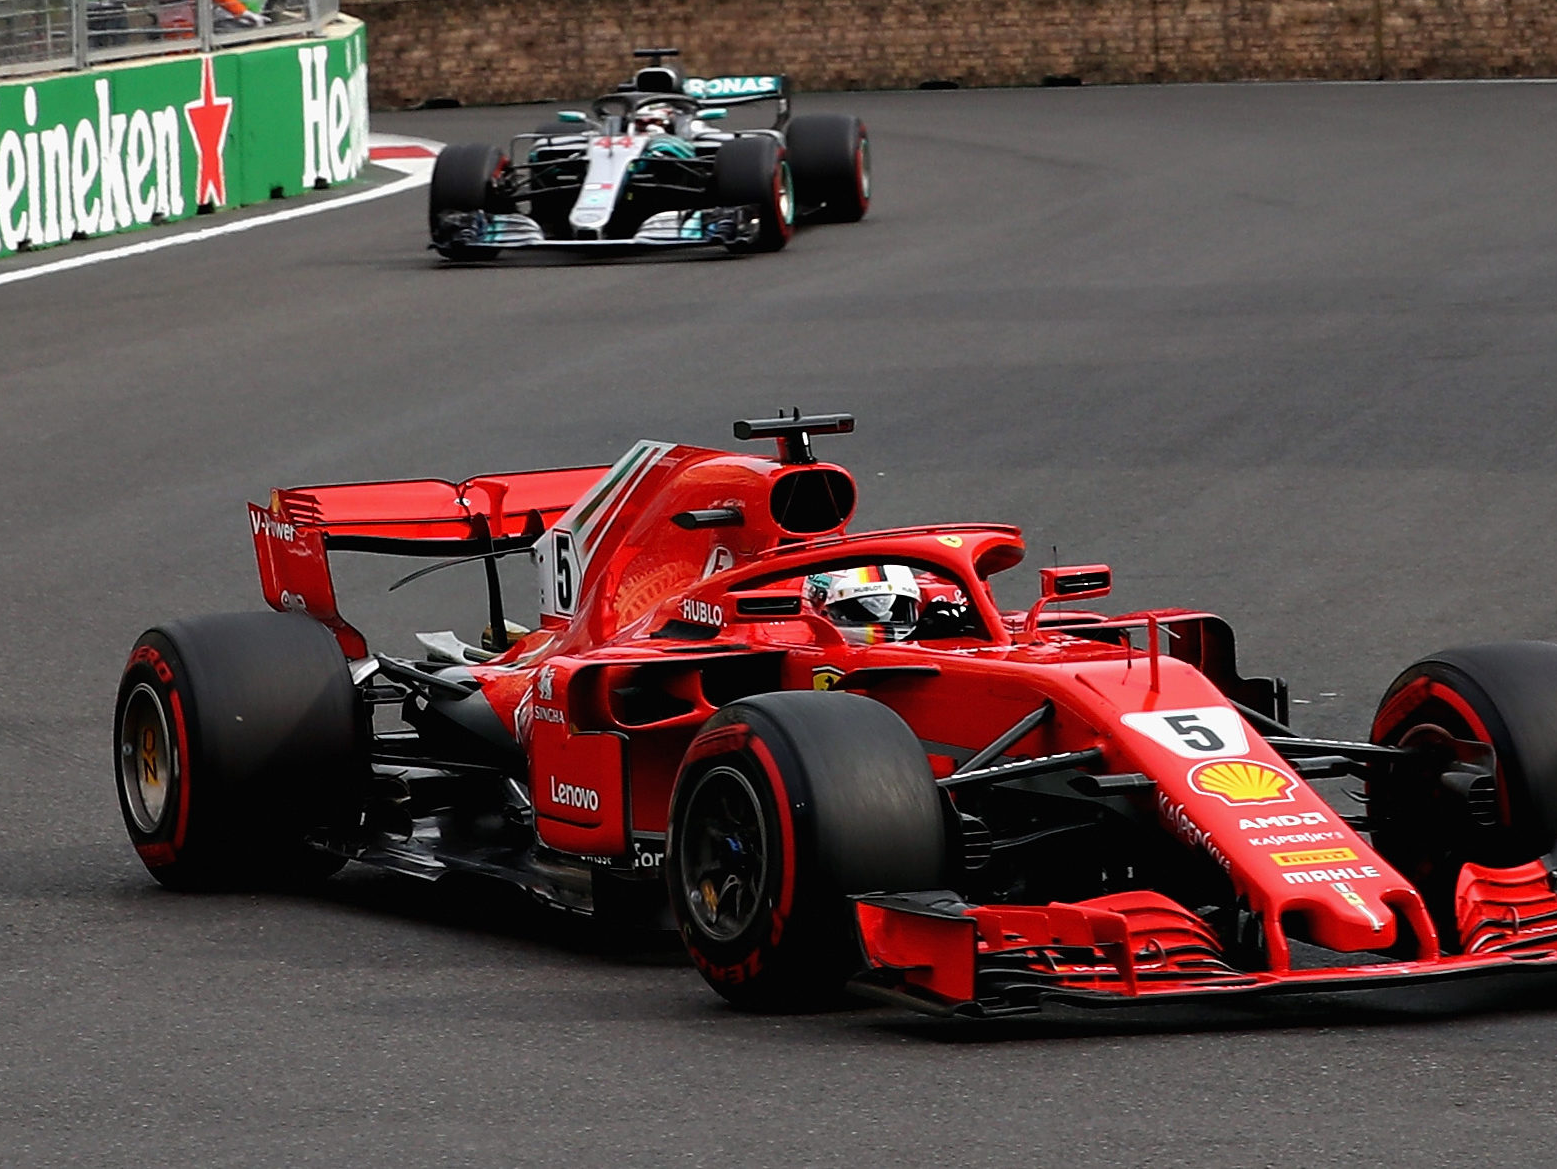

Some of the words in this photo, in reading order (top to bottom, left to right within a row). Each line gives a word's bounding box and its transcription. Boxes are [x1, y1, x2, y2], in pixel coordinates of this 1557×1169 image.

[594, 136, 634, 148] 44
[250, 510, 294, 543] V-Power
[554, 530, 573, 610] 5
[854, 584, 882, 594] HUBLOT
[682, 598, 728, 628] HUBLO
[1163, 714, 1226, 751] 5
[550, 775, 599, 811] Lenovo
[1239, 814, 1303, 830] AMD
[1249, 832, 1333, 846] KASPERSKY
[1282, 865, 1380, 884] MAHLE
